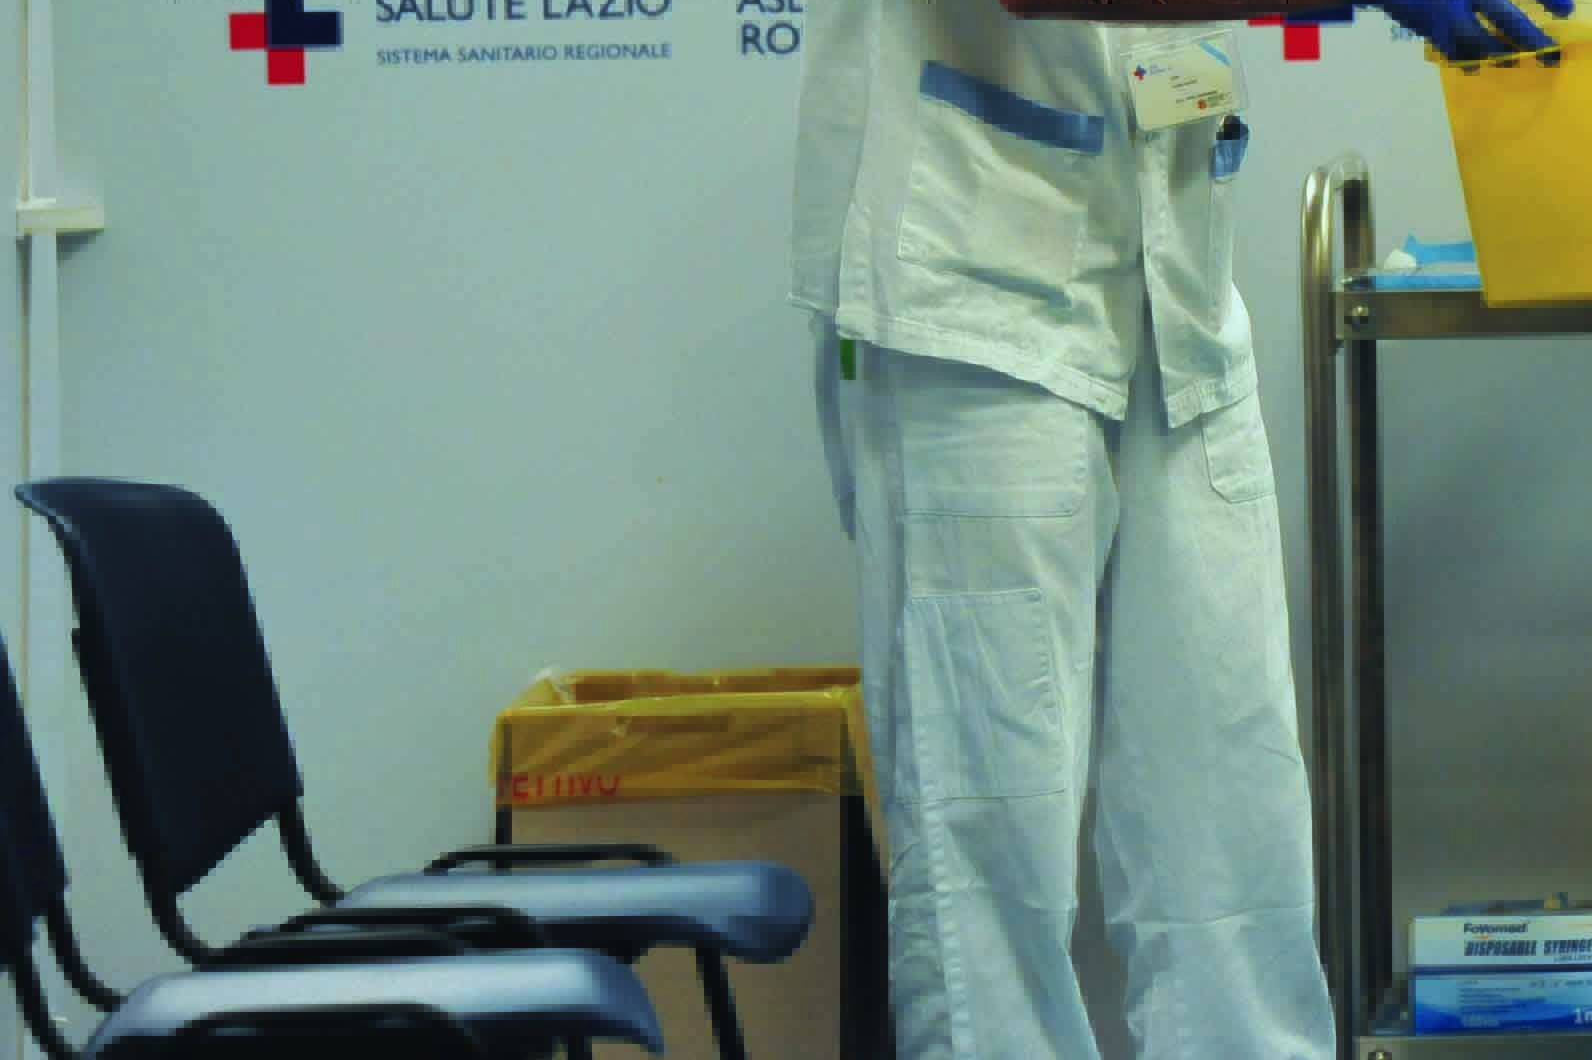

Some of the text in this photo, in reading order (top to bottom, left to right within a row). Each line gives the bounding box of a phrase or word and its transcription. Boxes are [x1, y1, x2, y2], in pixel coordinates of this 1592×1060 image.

[741, 22, 801, 56] RO
[377, 42, 672, 66] SISTEMA SANITARIO REGIONALE
[1465, 938, 1592, 957] DISPOSABLE SYRINGE
